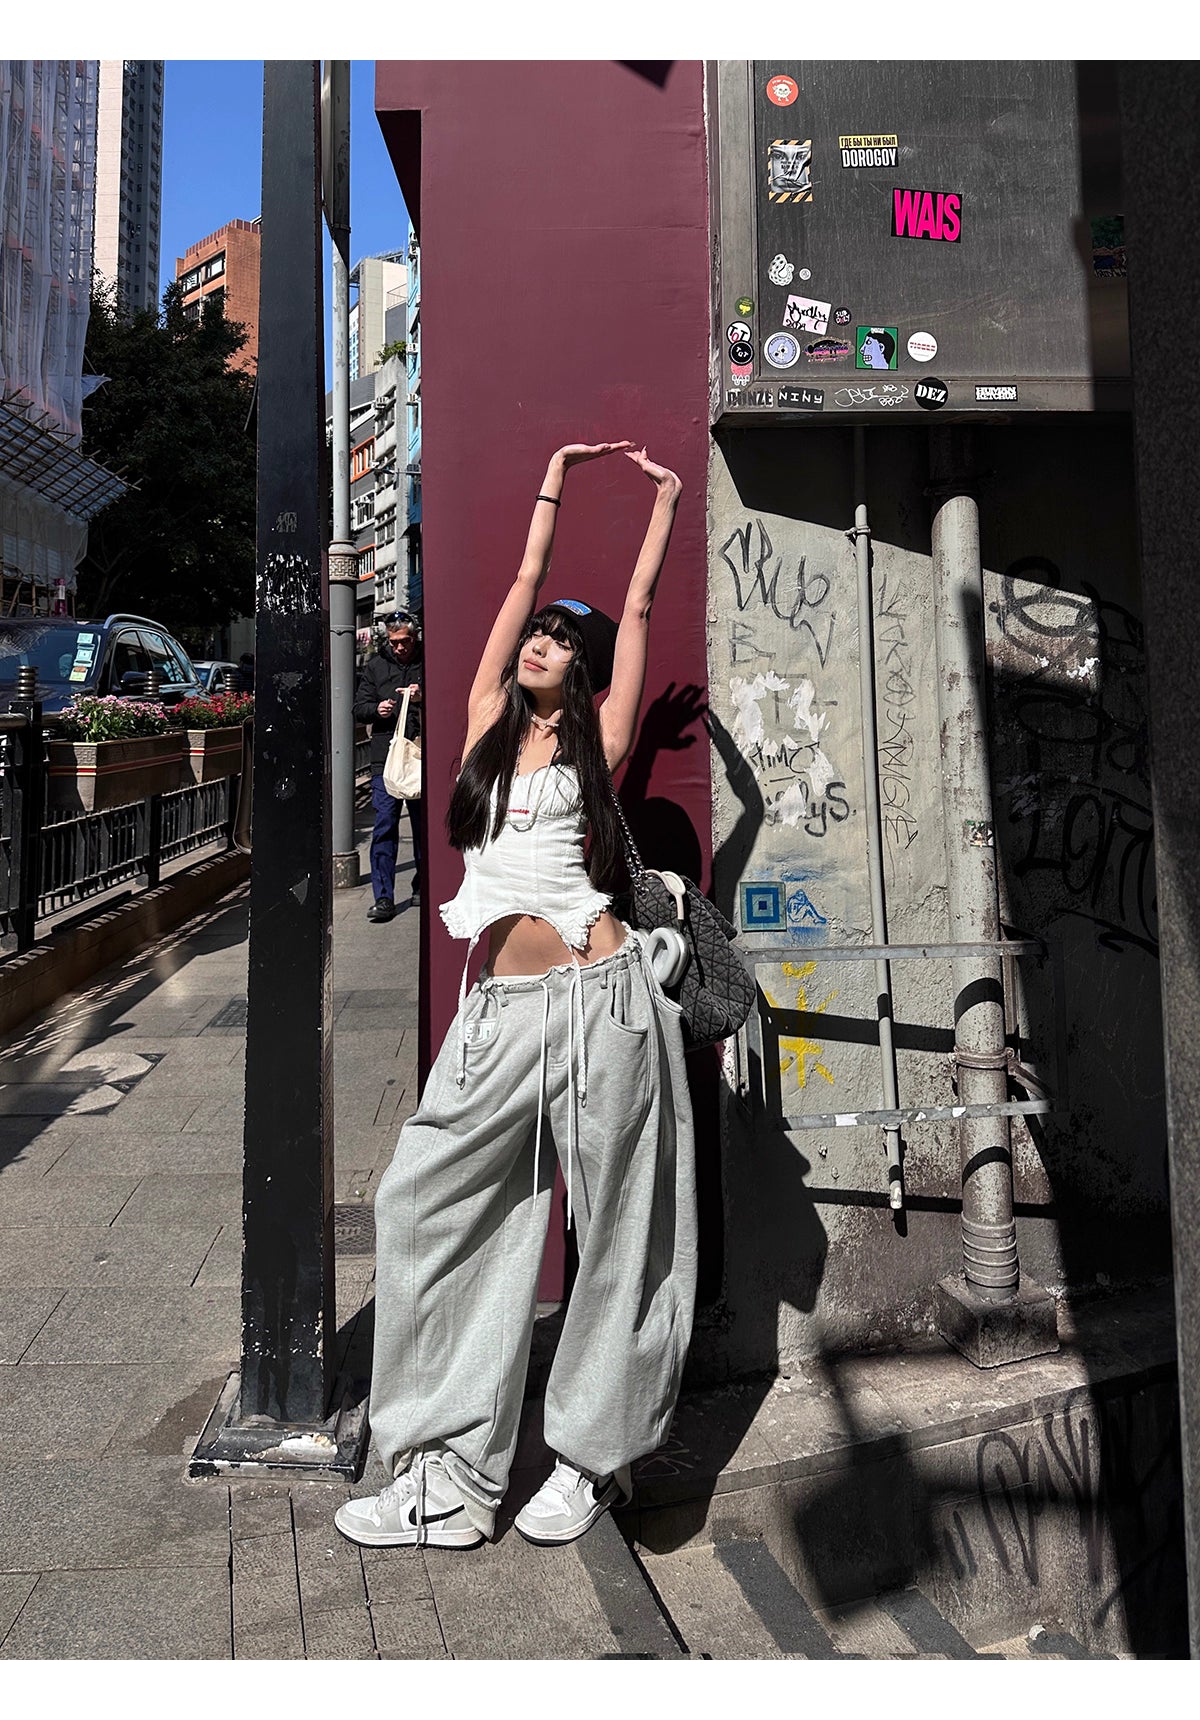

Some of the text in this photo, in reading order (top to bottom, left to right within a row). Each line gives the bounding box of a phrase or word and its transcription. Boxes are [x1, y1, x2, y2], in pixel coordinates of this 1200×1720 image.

[841, 137, 852, 148] ГДЕ
[863, 137, 873, 146] ТЫ
[842, 148, 897, 168] DOROGOY
[894, 189, 960, 241] WAIS
[916, 384, 947, 403] DEZ
